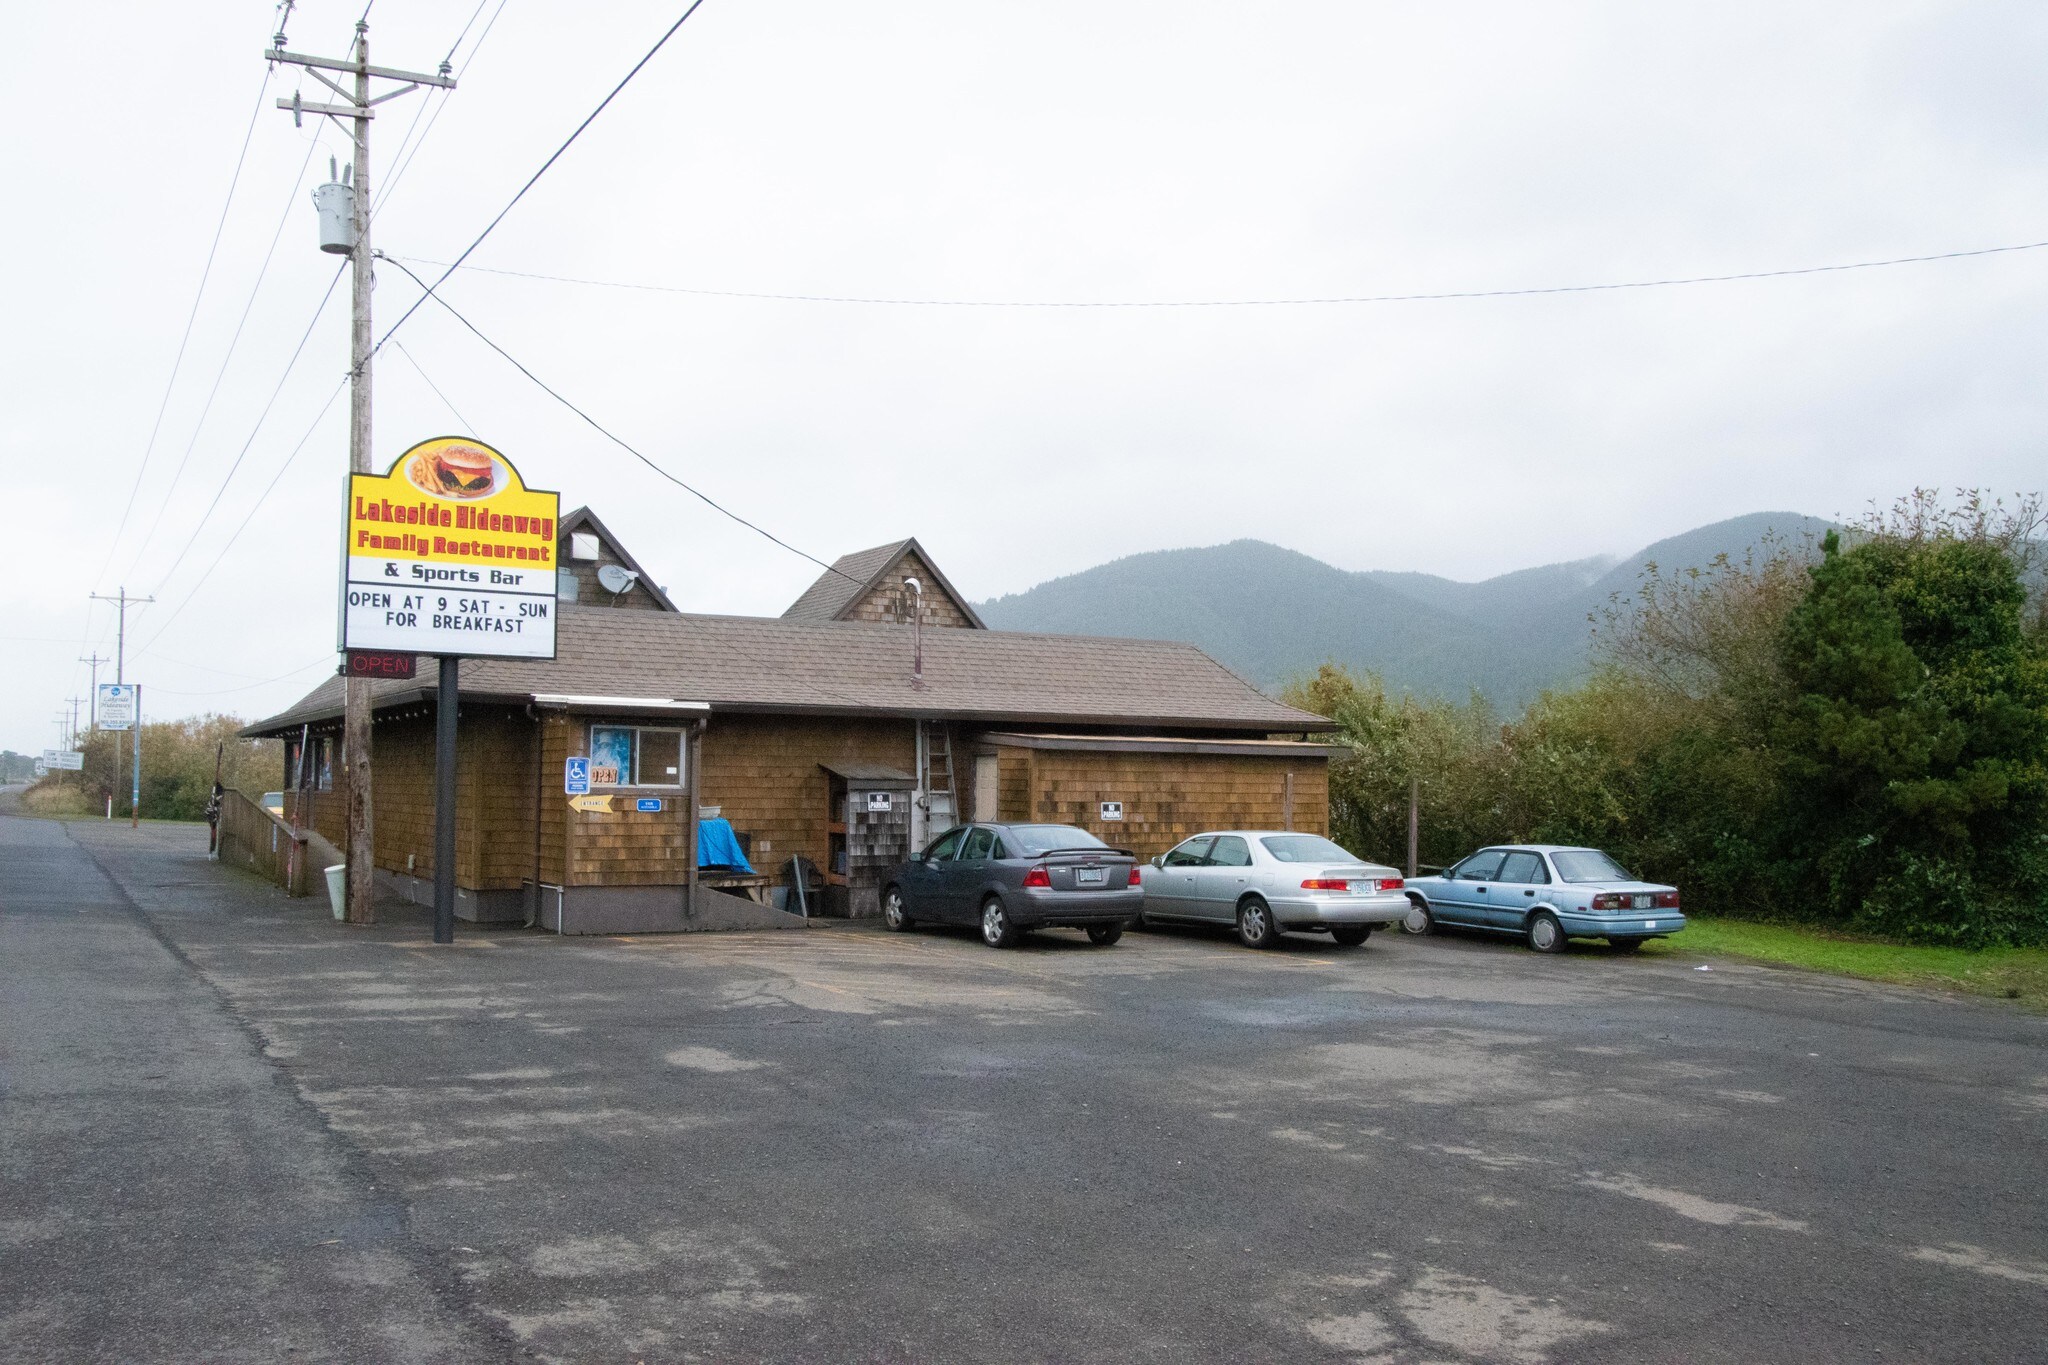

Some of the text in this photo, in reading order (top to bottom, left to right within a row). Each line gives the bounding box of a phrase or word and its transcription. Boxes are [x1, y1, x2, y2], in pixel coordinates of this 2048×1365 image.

[355, 496, 553, 542] Lakeside Hideaway
[358, 530, 550, 562] Family Restaurant
[384, 562, 524, 586] & Sports Bar
[349, 591, 391, 608] OPEN
[403, 596, 424, 610] AT
[437, 597, 447, 612] 9
[459, 598, 490, 614] SAT
[518, 603, 548, 618] SUN
[386, 612, 524, 633] FOR BREAKFAST
[353, 655, 409, 673] OPEN
[591, 767, 618, 783] OPEN
[870, 801, 889, 809] PARKING
[876, 794, 884, 802] NO
